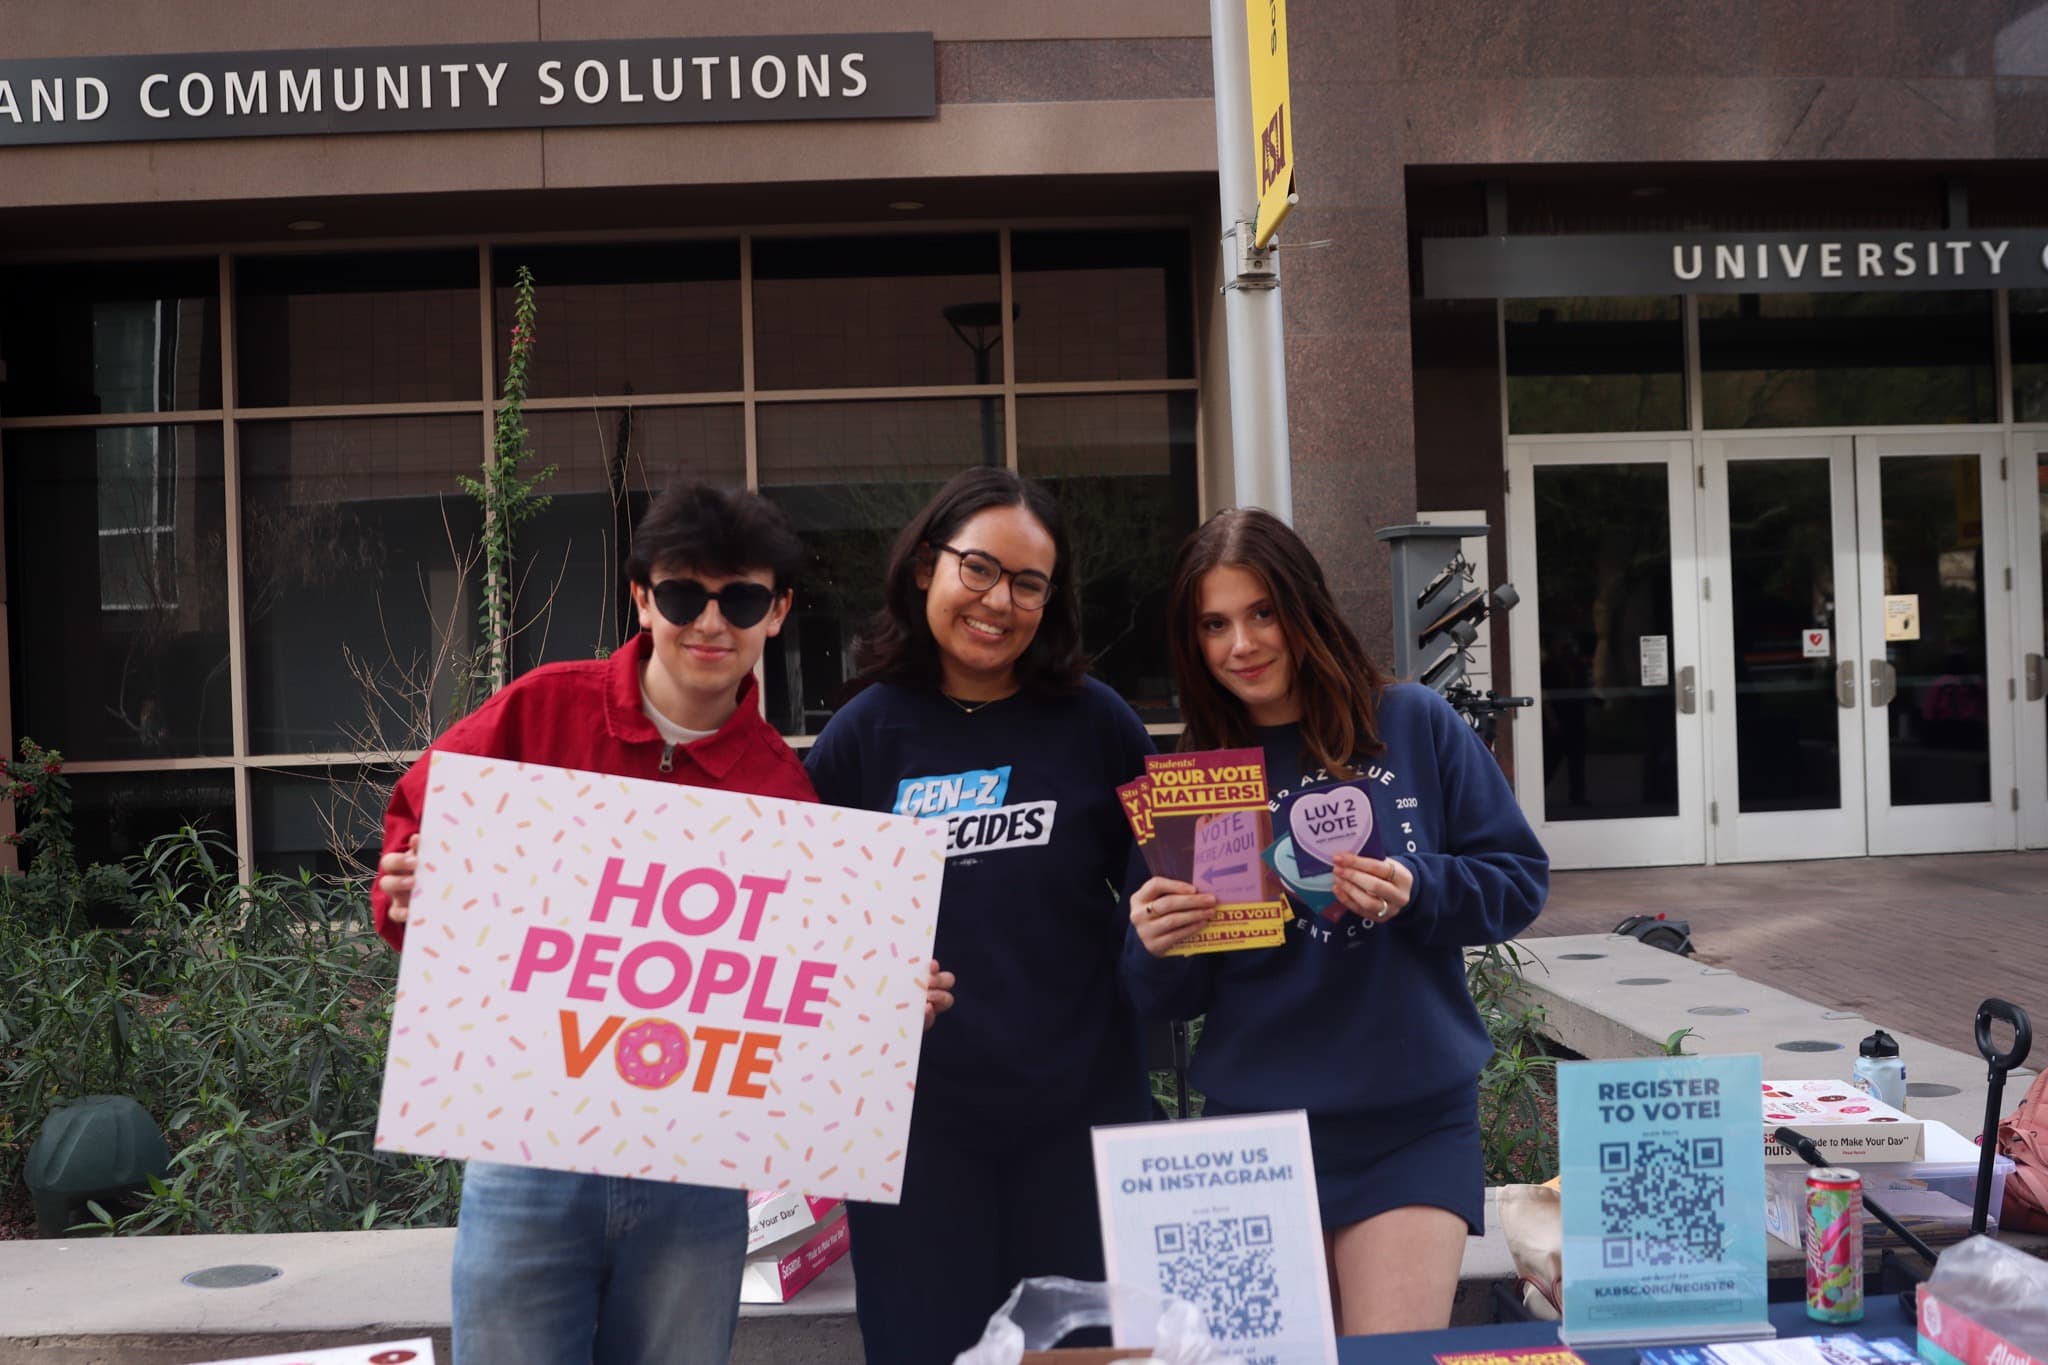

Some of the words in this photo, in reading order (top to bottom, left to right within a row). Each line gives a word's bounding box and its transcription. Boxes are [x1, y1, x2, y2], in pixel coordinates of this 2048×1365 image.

[0, 75, 110, 124] AND
[139, 61, 509, 119] COMMUNITY
[539, 52, 869, 106] SOLUTIONS
[1673, 240, 2010, 281] UNIVERSITY
[1148, 758, 1196, 770] Students!
[1150, 769, 1206, 786] YOUR
[1208, 764, 1263, 782] VOTE
[902, 775, 1000, 817] GEN-Z
[1156, 784, 1261, 805] MATTERS!
[1304, 801, 1340, 821] LUV
[1344, 799, 1356, 812] 2
[947, 807, 1045, 850] ECIDES
[1202, 811, 1245, 844] VOTE
[1308, 814, 1358, 836] VOTE
[589, 856, 787, 942] HOT
[1227, 911, 1244, 920] TO
[1247, 908, 1278, 919] VOTE
[509, 926, 838, 1028] PEOPLE
[558, 1009, 782, 1100] VOTE
[1599, 1078, 1720, 1100] REGISTER
[1599, 1104, 1635, 1124] TO
[1642, 1100, 1720, 1121] VOTE!
[1841, 1137, 1863, 1147] Make
[1865, 1137, 1885, 1146] Your
[1142, 1152, 1234, 1173] FOLLOW
[1241, 1148, 1269, 1164] US
[1121, 1178, 1153, 1194] ON
[1160, 1165, 1293, 1191] INSTAGRAM!
[759, 1215, 778, 1229] Your
